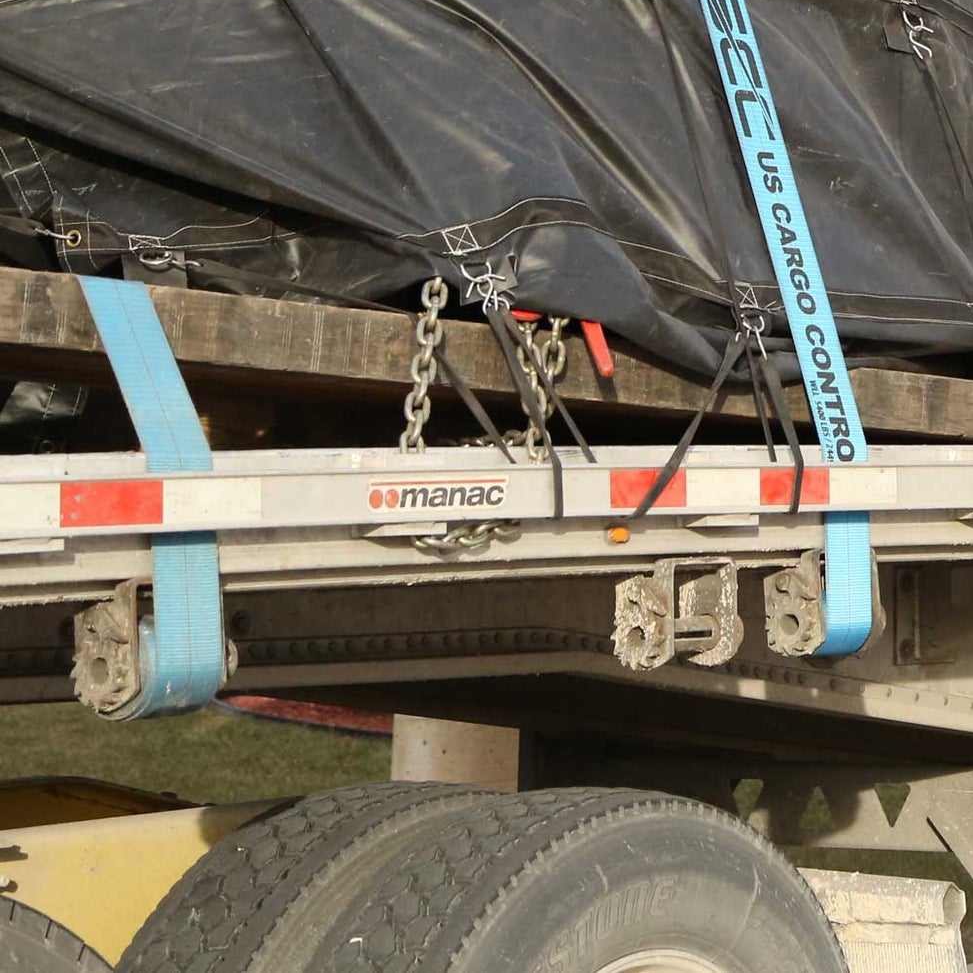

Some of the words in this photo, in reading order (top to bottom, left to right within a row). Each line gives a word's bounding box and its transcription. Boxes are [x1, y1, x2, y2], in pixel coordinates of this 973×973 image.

[757, 151, 783, 194] US
[771, 202, 817, 317] CARGO
[804, 324, 855, 463] CONTRO
[400, 485, 504, 507] manac
